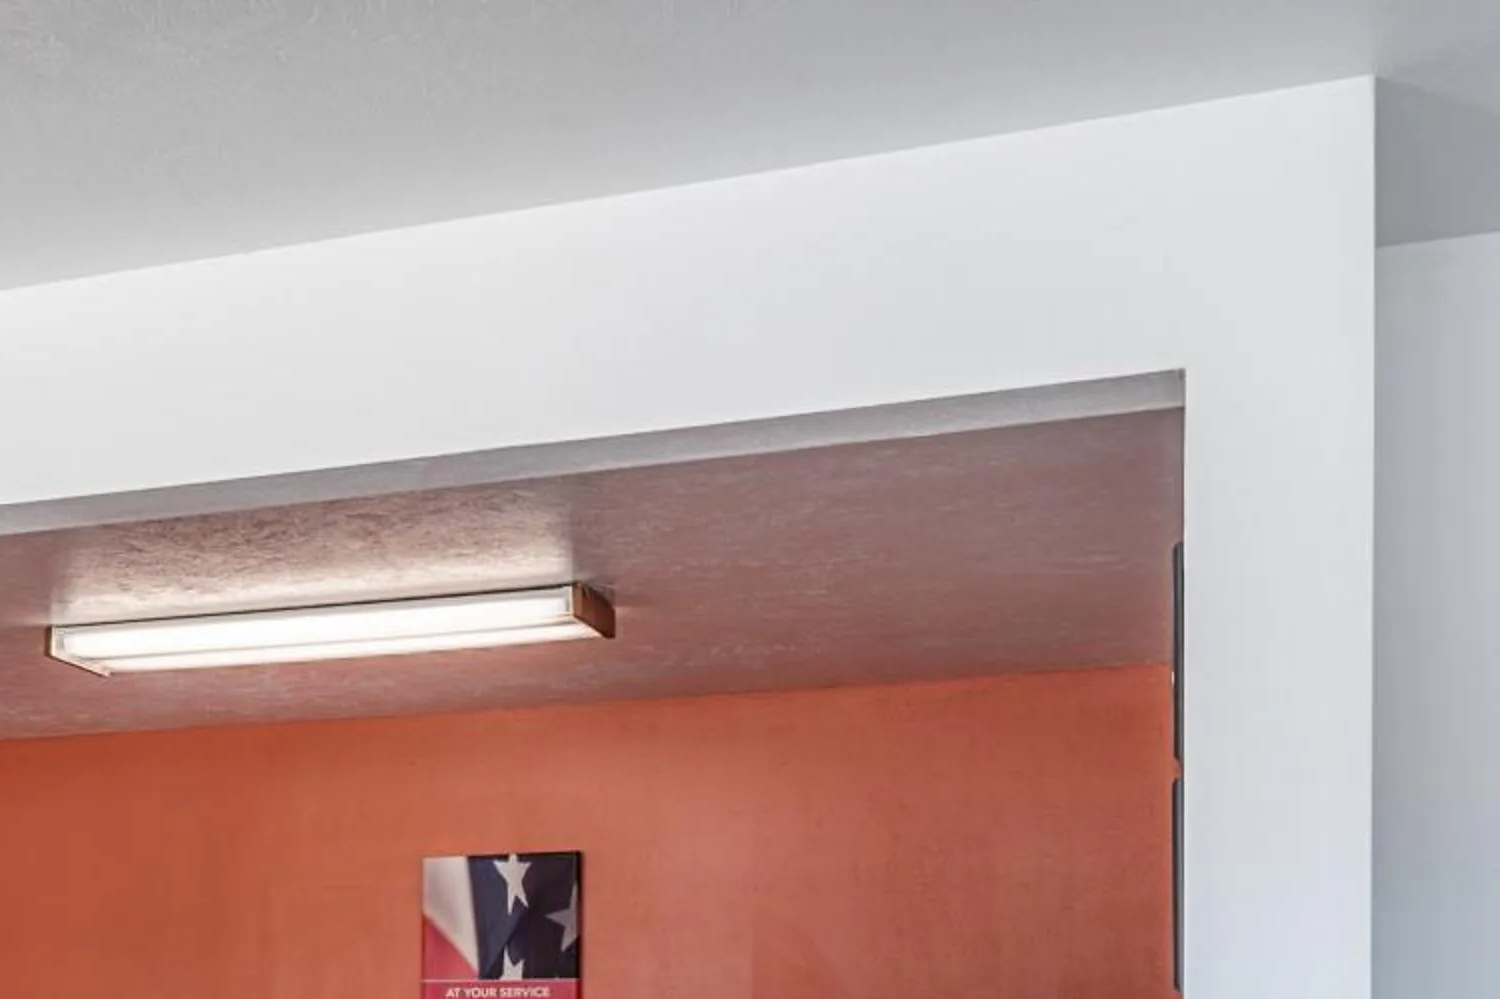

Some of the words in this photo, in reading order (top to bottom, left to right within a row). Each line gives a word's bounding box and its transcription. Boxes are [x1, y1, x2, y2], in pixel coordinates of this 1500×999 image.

[445, 987, 461, 999] AT
[464, 986, 497, 999] YOUR
[498, 986, 550, 999] SERVICE
